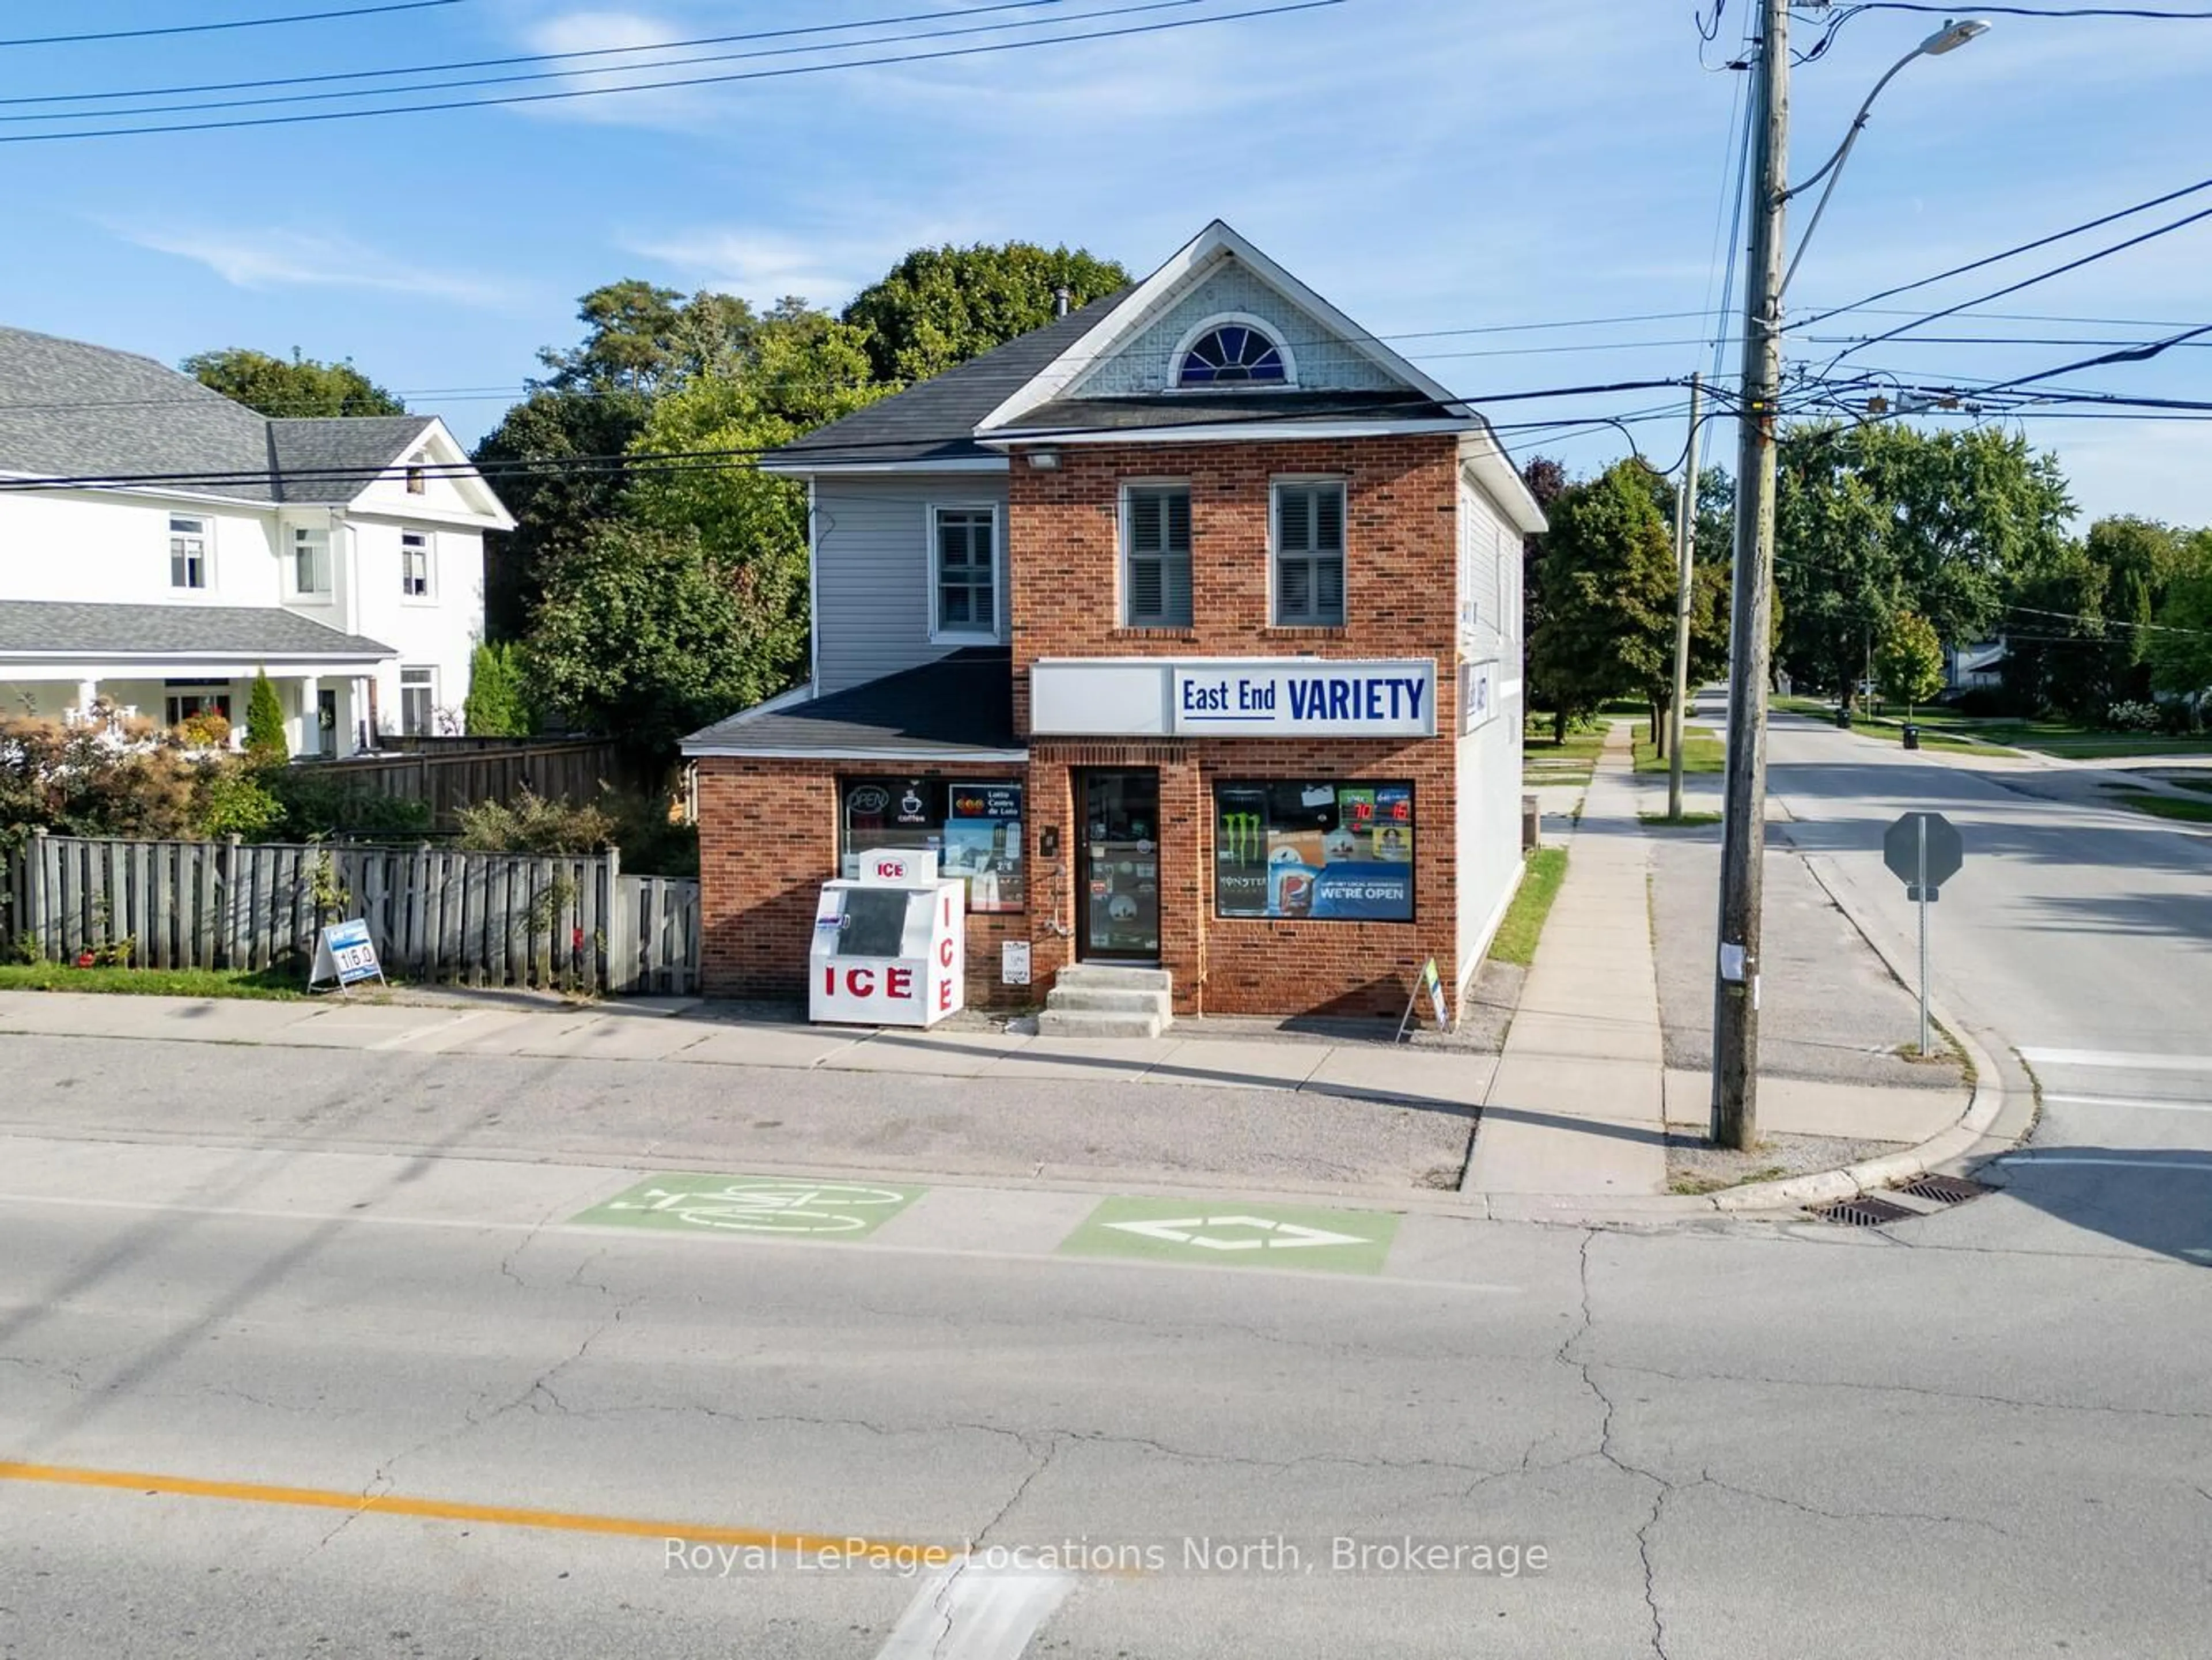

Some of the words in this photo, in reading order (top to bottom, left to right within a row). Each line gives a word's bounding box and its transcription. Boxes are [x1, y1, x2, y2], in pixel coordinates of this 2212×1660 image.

[1184, 680, 1228, 710] East
[1239, 680, 1275, 710] End
[1288, 678, 1425, 720] VARIETY
[851, 792, 885, 807] OPEN
[897, 815, 926, 823] coffee
[877, 863, 904, 877] ICE
[1320, 887, 1363, 899] WE'RE
[1365, 887, 1404, 900] OPEN
[940, 897, 953, 1011] ICE
[825, 967, 912, 999] ICE
